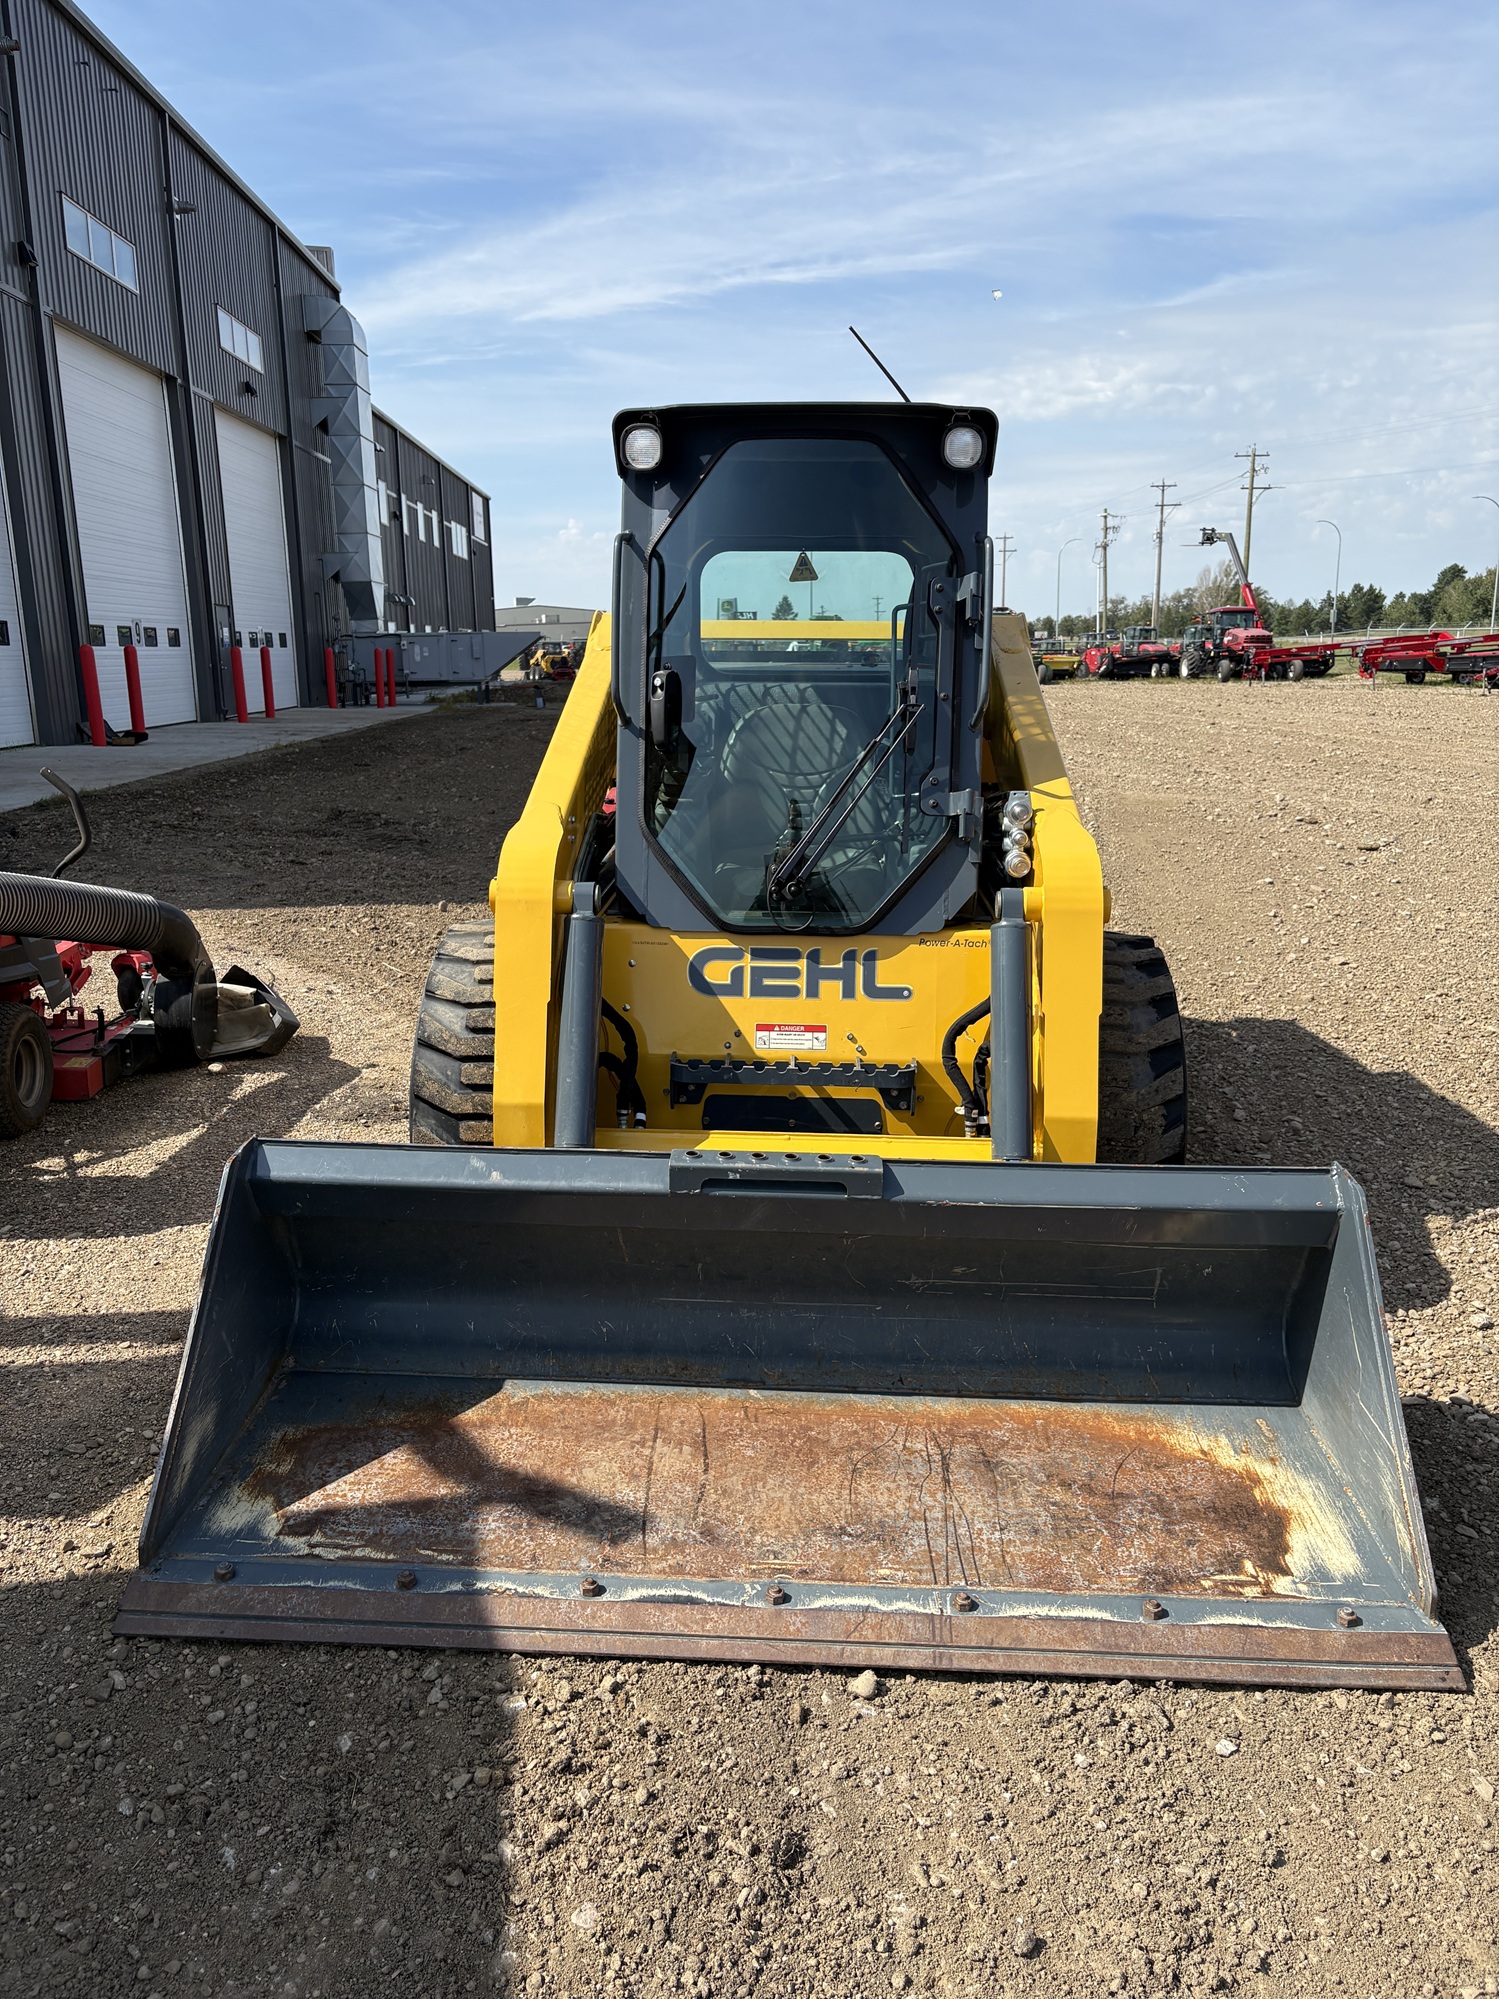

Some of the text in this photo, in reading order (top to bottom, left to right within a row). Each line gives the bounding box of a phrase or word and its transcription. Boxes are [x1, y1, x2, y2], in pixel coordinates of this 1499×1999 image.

[135, 621, 140, 644] 9
[918, 937, 988, 949] Power-A-Tach
[687, 945, 914, 1002] GEHL
